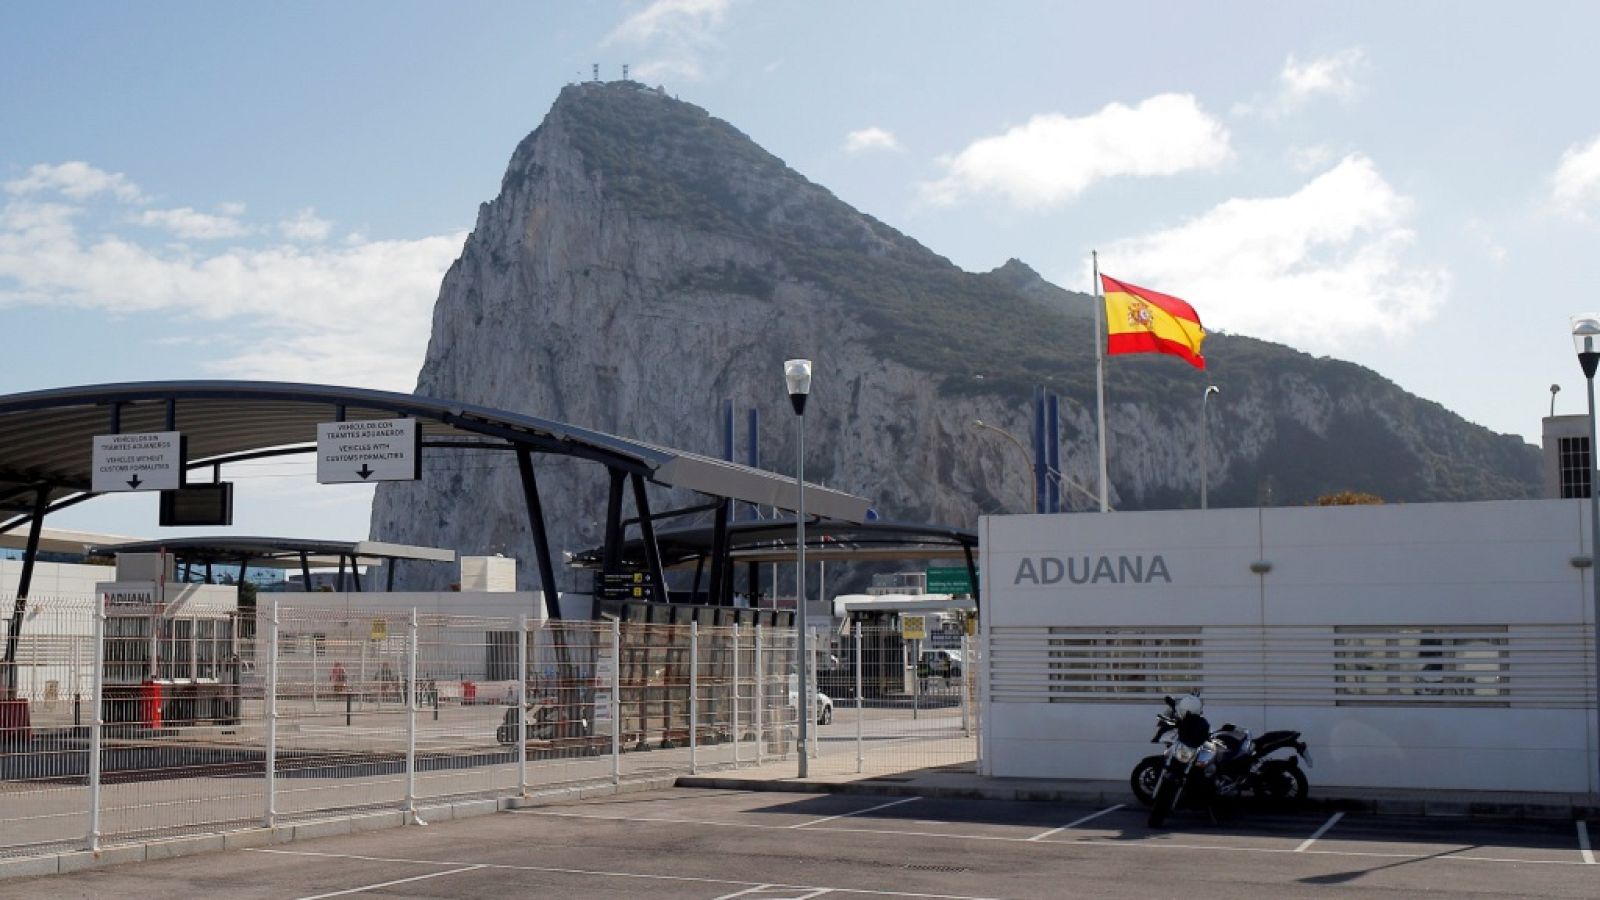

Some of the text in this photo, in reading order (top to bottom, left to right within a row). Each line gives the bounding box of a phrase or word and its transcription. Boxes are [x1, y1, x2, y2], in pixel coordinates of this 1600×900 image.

[339, 443, 390, 452] VEHICLES WITH
[136, 454, 164, 462] WITHOUT
[326, 452, 404, 462] CUSTOMS FORMALITIES
[130, 463, 170, 471] FORMALITIES
[1014, 555, 1172, 585] ADUANA
